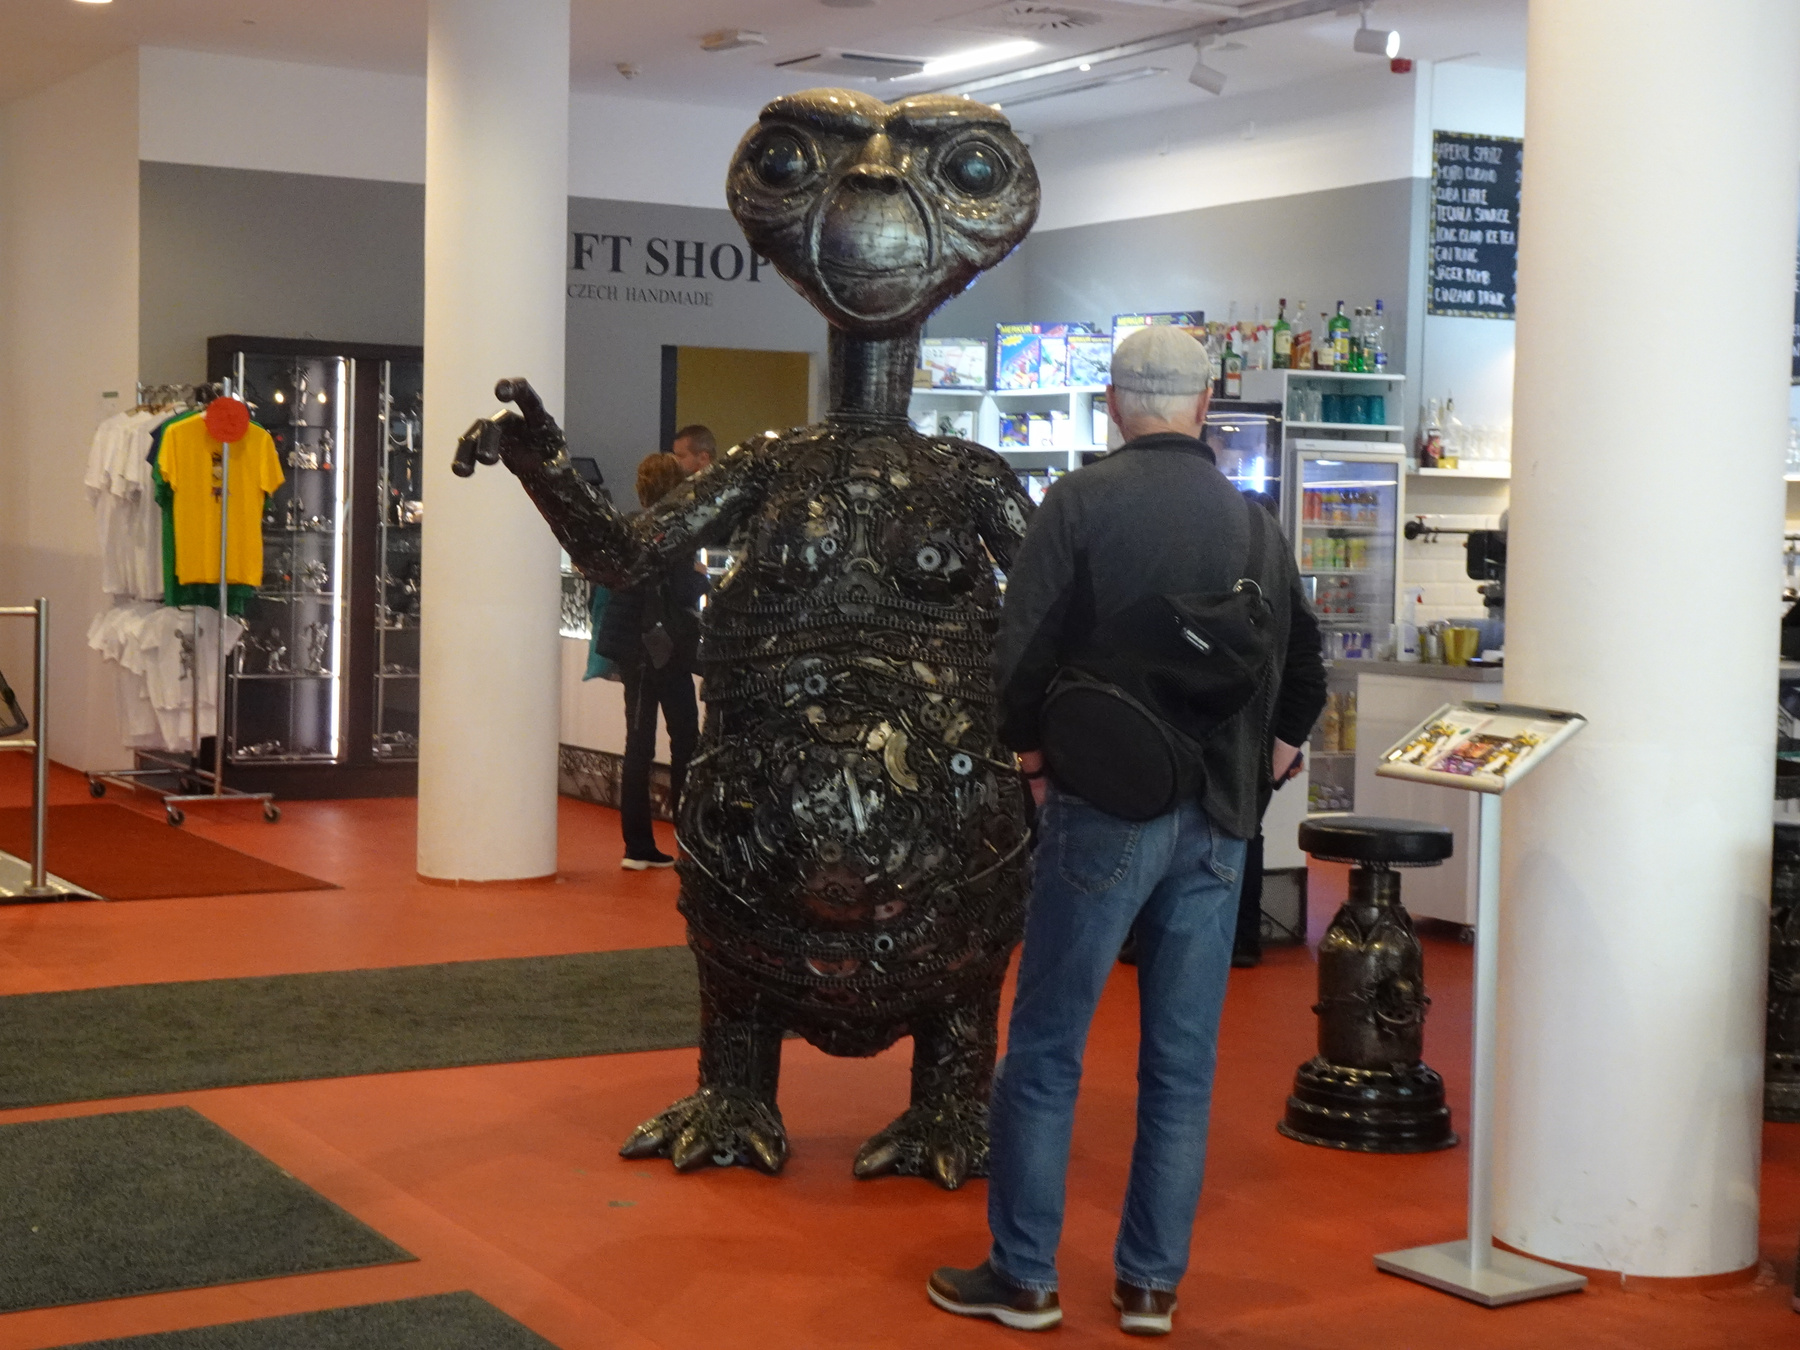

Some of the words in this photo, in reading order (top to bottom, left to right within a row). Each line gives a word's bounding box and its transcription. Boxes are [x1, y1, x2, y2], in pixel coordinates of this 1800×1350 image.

[573, 232, 632, 273] FT
[645, 237, 771, 283] SHOP
[566, 284, 618, 302] CZECH
[626, 286, 714, 307] HANDMADE
